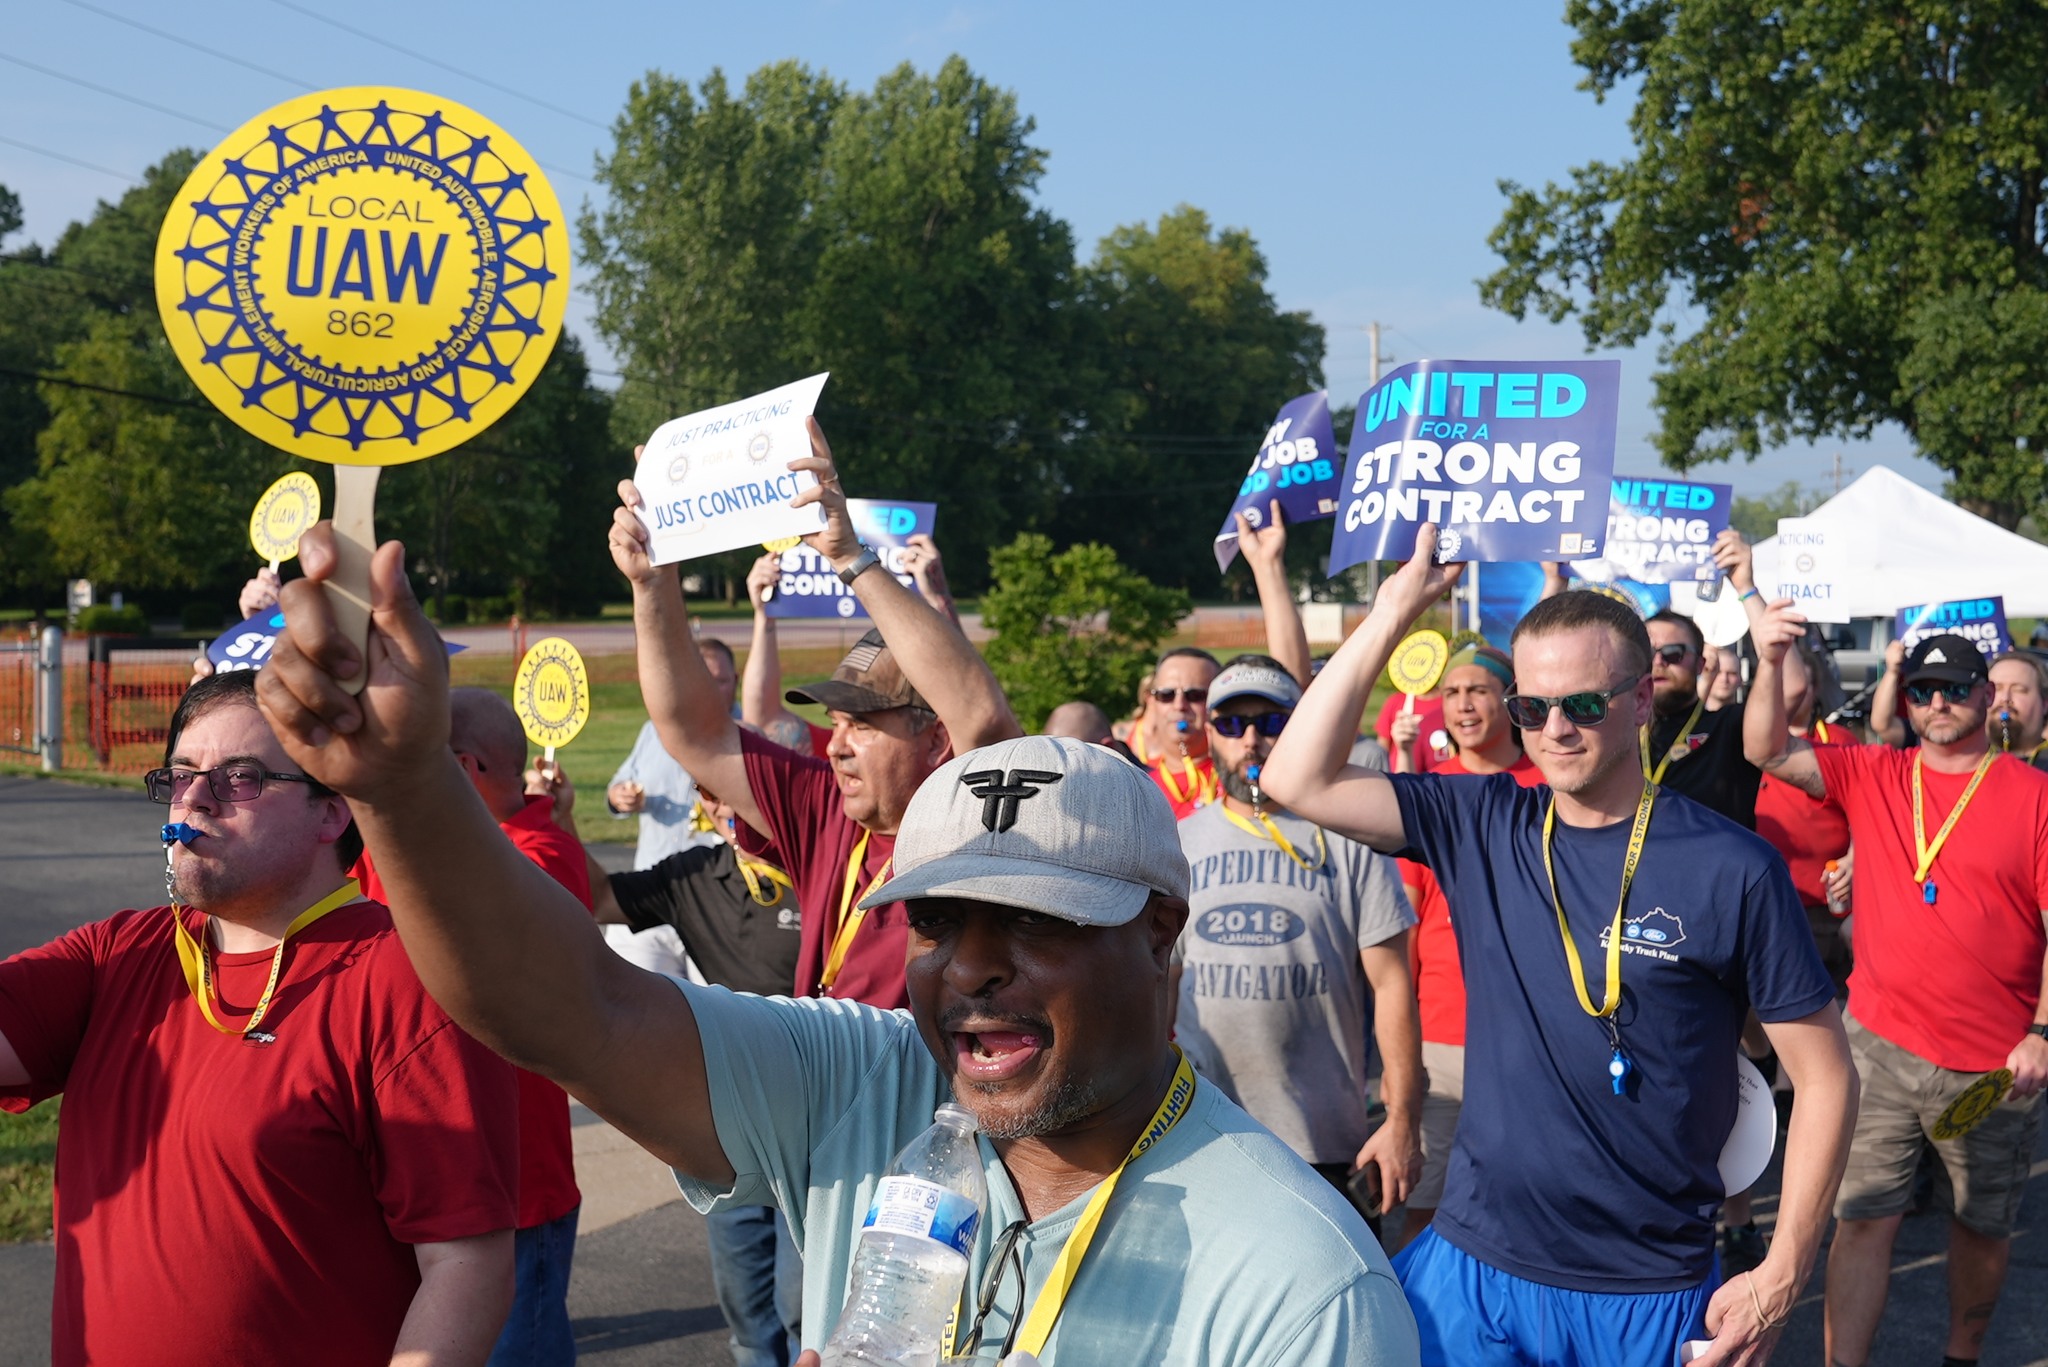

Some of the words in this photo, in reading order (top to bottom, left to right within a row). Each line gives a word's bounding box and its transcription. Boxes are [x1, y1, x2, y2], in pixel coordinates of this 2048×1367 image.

[295, 150, 368, 182] AMERICA
[384, 151, 442, 179] UNITED
[272, 175, 293, 195] OF
[308, 195, 434, 223] LOCAL
[439, 175, 498, 266] AUTOMOBILE,
[233, 193, 276, 266] WORKERS
[286, 225, 450, 305] UAW
[233, 270, 286, 357] IMPLEMENT
[327, 310, 394, 338] 862
[442, 269, 498, 361] AEROSPACE
[285, 351, 408, 392] AGRICULTURAL
[411, 355, 445, 382] AND
[1364, 372, 1588, 433] UNITED
[666, 427, 702, 449] JUST
[701, 400, 792, 439] PRACTICING
[1418, 421, 1468, 440] FOR
[1476, 423, 1489, 440] A
[1262, 437, 1319, 469] JOB
[1352, 440, 1582, 494] STRONG
[1276, 459, 1335, 488] JOB
[655, 498, 694, 529] JUST
[698, 472, 800, 518] CONTRACT
[1344, 489, 1585, 533] CONTRACT
[1611, 479, 1715, 511] NITED
[272, 507, 299, 525] UAW
[1606, 515, 1710, 543] TRONG
[540, 682, 567, 703] UAW
[1625, 851, 1637, 874] FOR
[1634, 799, 1650, 839] STRONG
[1191, 850, 1335, 902] XPEDITION
[1207, 910, 1290, 933] 2018
[1223, 933, 1274, 945] LAUNCH
[1636, 945, 1658, 958] Truck
[1659, 950, 1679, 962] Plant
[1138, 1076, 1191, 1152] FIGHTING
